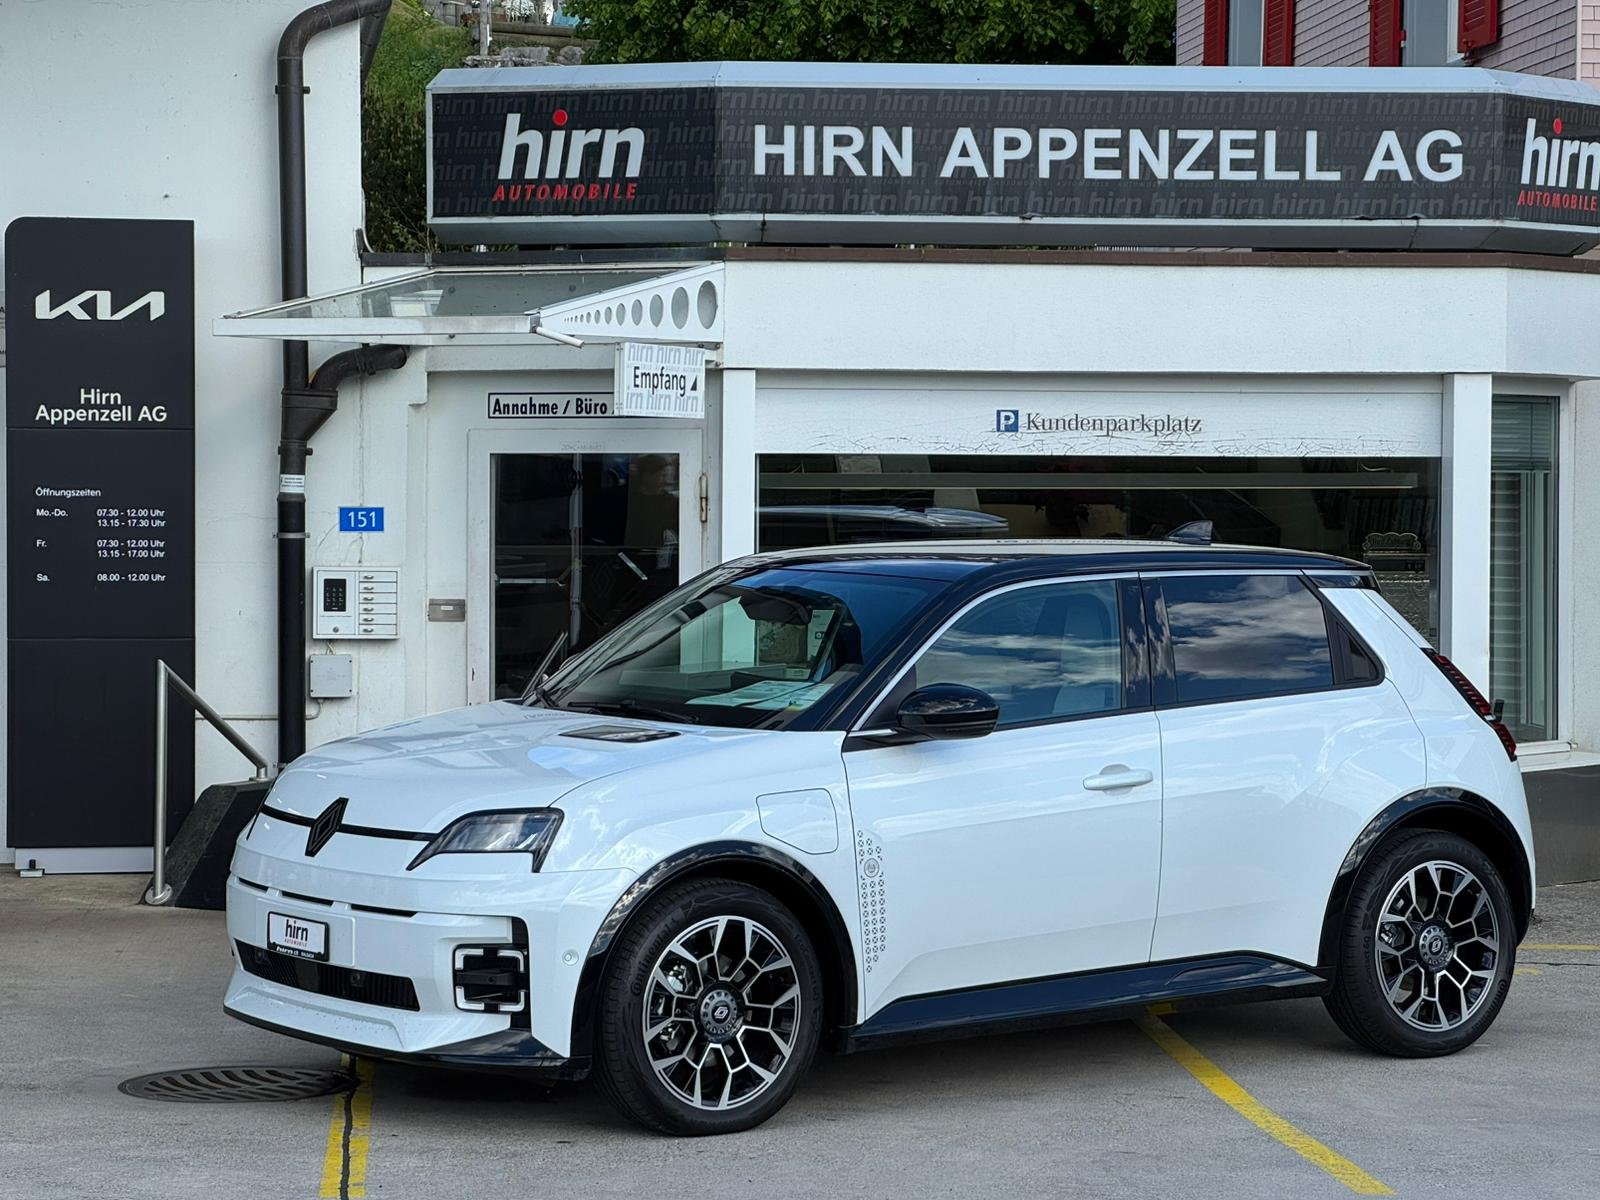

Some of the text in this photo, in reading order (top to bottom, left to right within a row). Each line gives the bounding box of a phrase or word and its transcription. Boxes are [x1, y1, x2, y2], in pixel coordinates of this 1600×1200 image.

[497, 108, 646, 180] hirn
[753, 124, 1465, 183] HIRN APPENZELL AG
[1520, 117, 1600, 191] hirn
[492, 183, 639, 202] AUTOMOBILE
[1517, 190, 1598, 212] AUTOMOBILE
[633, 366, 687, 397] Empfang
[80, 388, 122, 404] Hirn
[492, 398, 559, 415] Annahme
[575, 396, 608, 415] Büro
[35, 404, 168, 425] Appenzell AG
[1026, 413, 1202, 436] Kundenparkplatz
[35, 486, 102, 499] Öffnungszeiten
[36, 508, 69, 517] Mo.-Do.
[97, 509, 119, 517] 07.30
[127, 509, 149, 517] 12.00
[150, 509, 165, 517] Uhr
[348, 511, 376, 528] 151
[98, 519, 120, 527] 13.15
[128, 519, 150, 527] 17.30
[151, 519, 166, 527] Uhr
[36, 539, 48, 548] Fr.
[97, 540, 119, 548] 07.30
[127, 540, 149, 548] 12.00
[150, 540, 165, 548] Uhr
[97, 550, 119, 558] 13.15
[127, 550, 149, 558] 17.00
[150, 550, 165, 558] Uhr
[36, 573, 51, 582] Sa.
[98, 574, 120, 582] 08.00
[128, 574, 150, 582] 12.00
[151, 574, 166, 582] Uhr
[285, 919, 308, 941] hirn
